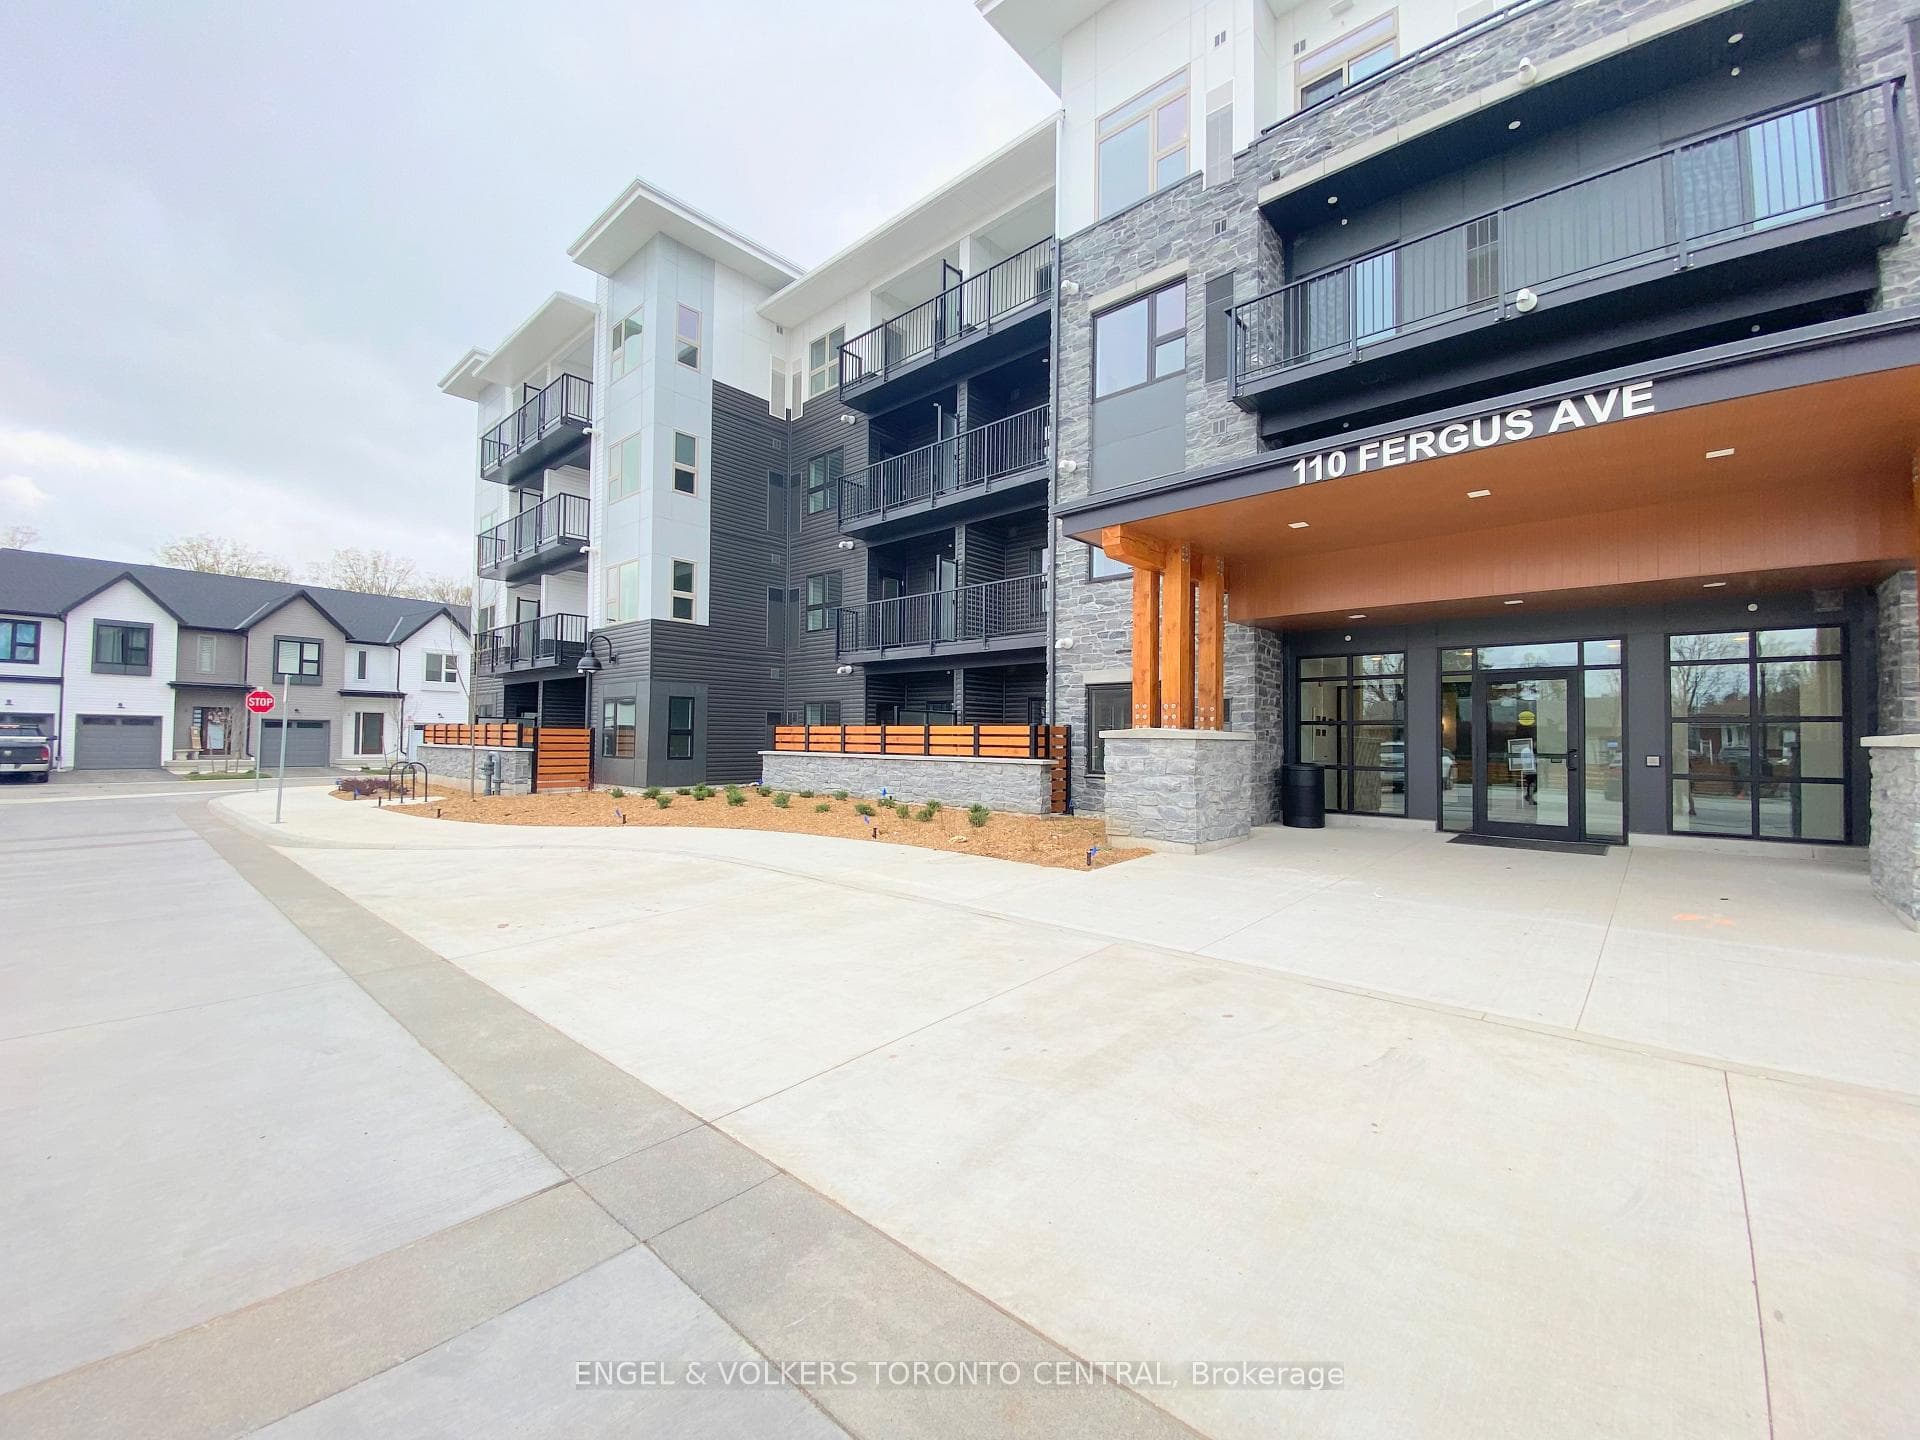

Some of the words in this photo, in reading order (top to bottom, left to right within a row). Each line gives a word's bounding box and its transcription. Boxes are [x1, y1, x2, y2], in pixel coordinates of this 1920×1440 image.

[1292, 450, 1347, 485] 110
[1358, 408, 1534, 472] FERGUS
[1548, 380, 1655, 433] AVE
[248, 697, 273, 707] STOP
